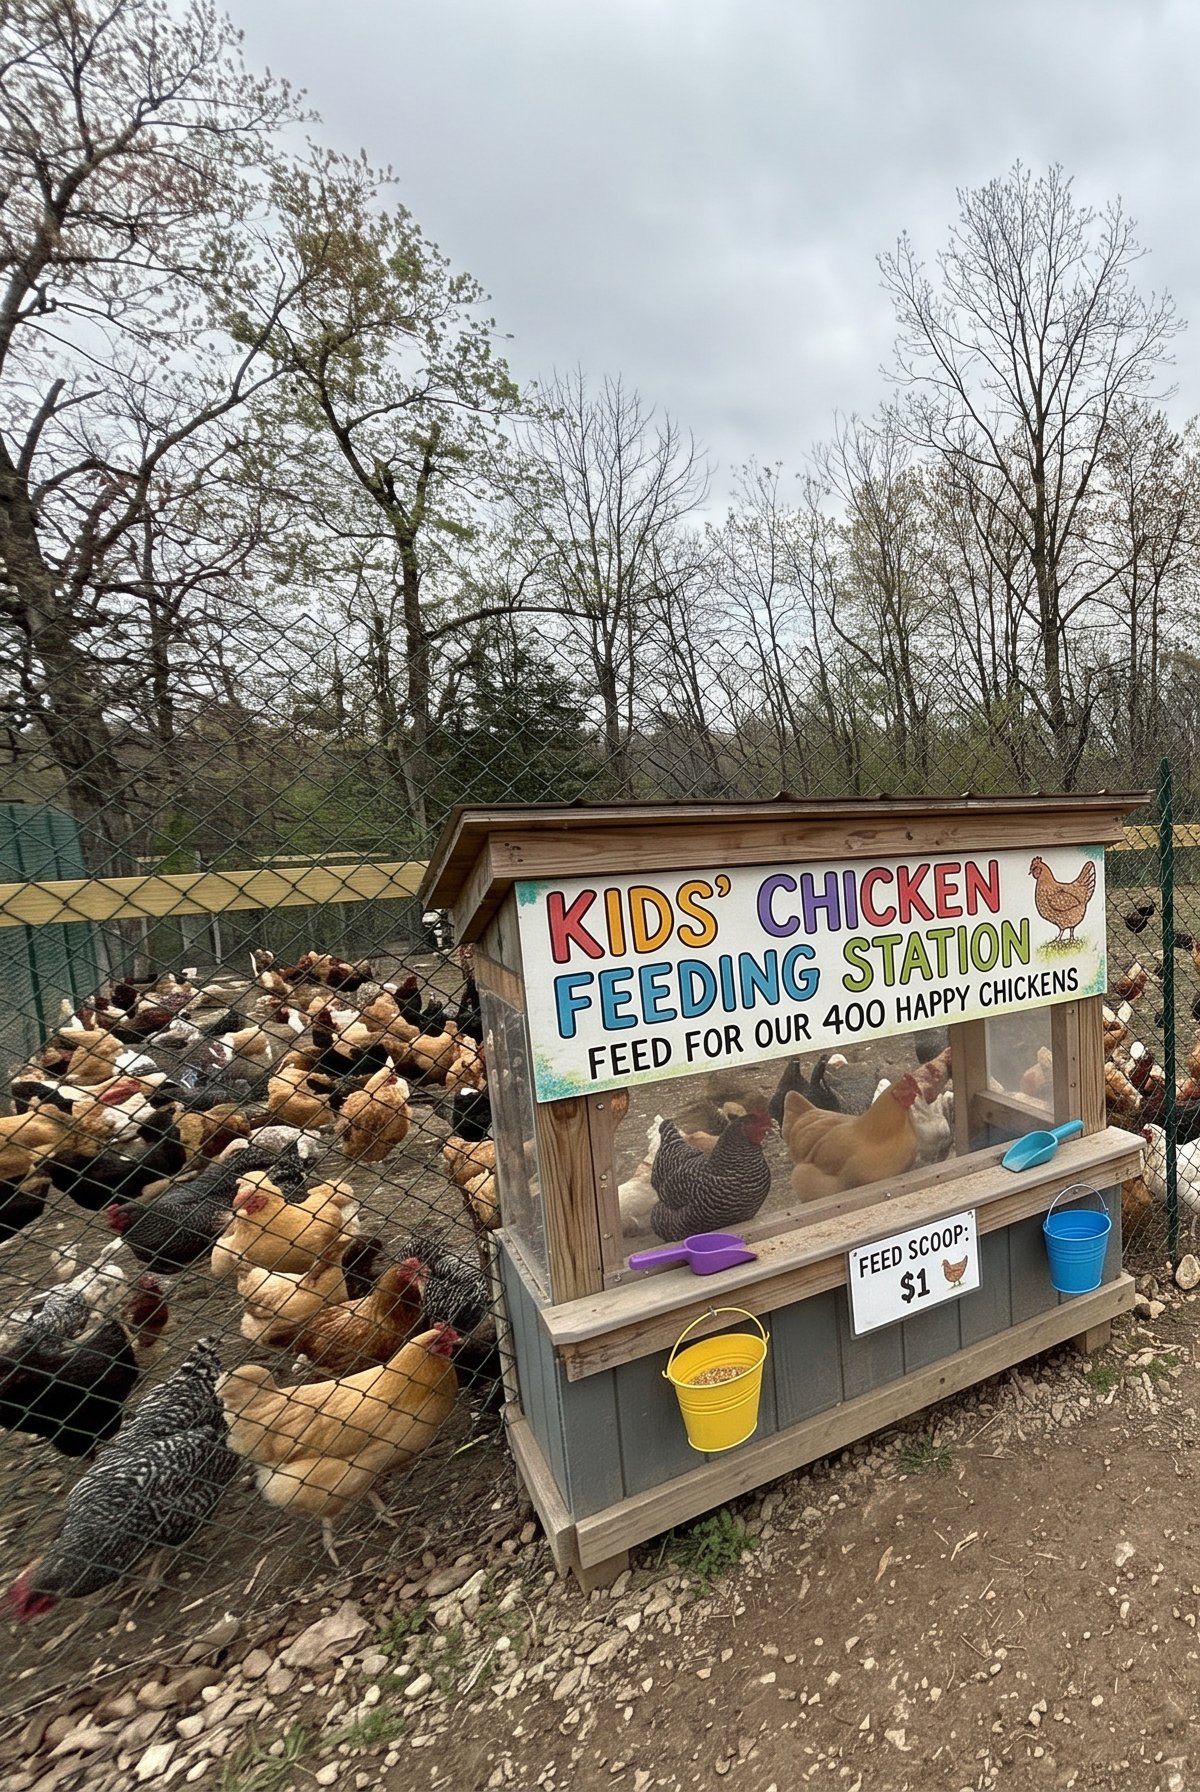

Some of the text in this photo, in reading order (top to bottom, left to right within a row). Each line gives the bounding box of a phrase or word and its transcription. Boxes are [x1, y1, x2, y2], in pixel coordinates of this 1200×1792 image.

[757, 859, 1001, 938] CHICKEN
[554, 918, 1030, 1039] FEEDING STATION
[588, 967, 1079, 1080] FEED FOR OUR 400 HAPPY CHICKENS
[859, 1224, 969, 1279] FEED SCOOP:
[900, 1268, 930, 1304] $1
